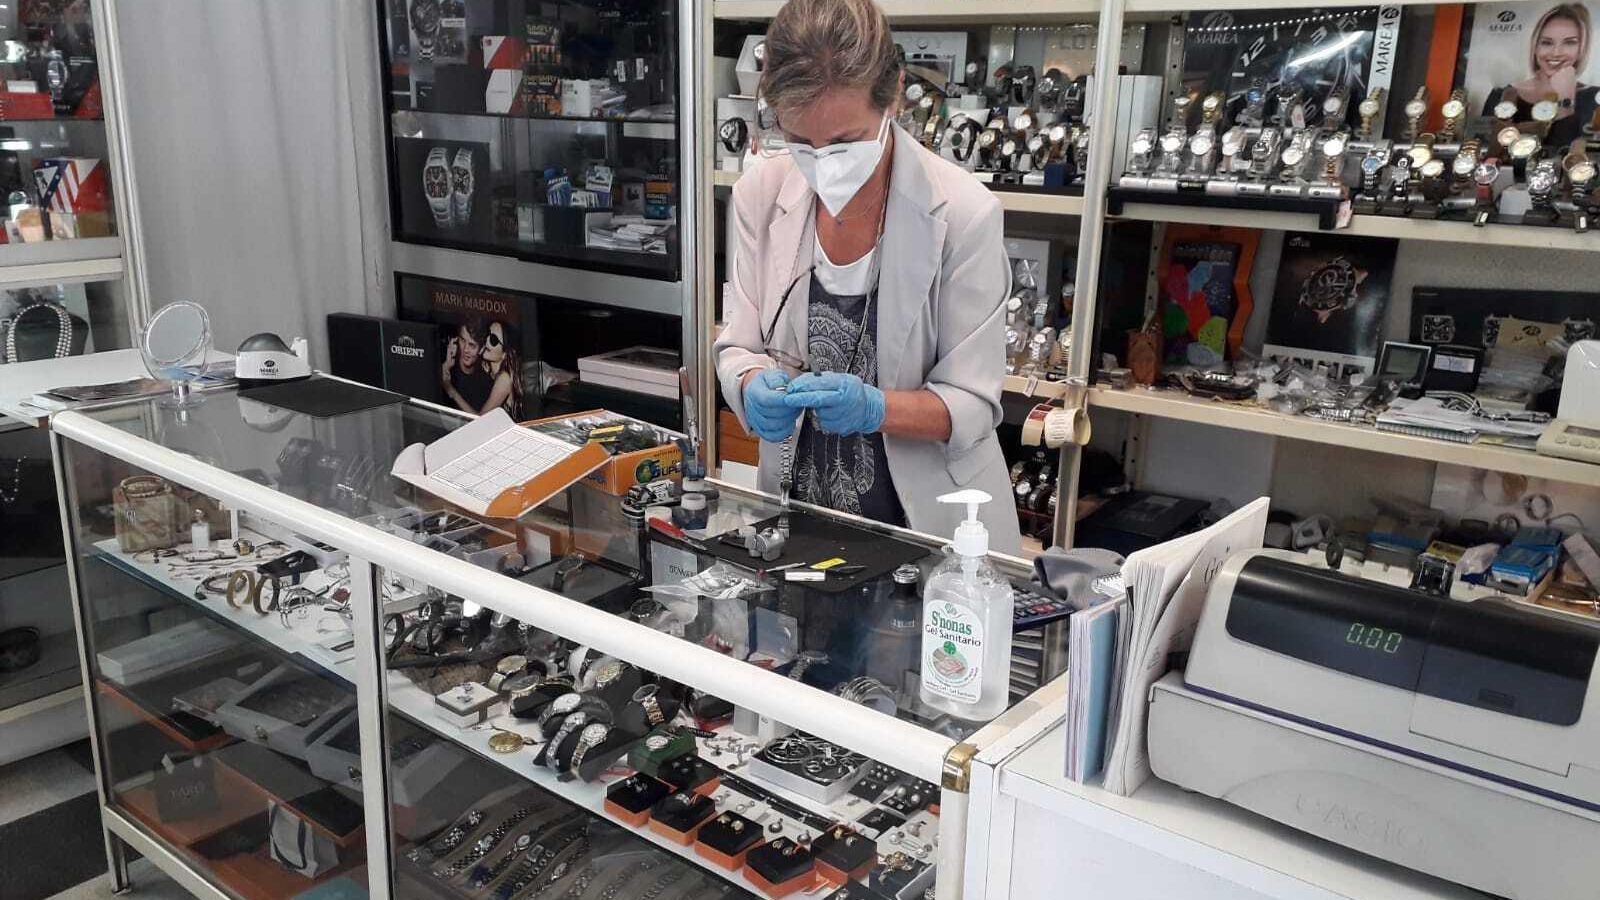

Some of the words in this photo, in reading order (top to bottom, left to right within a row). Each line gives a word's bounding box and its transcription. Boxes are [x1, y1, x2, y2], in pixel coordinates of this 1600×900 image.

[1194, 32, 1239, 45] MAREA
[1375, 21, 1395, 75] MAREA
[435, 291, 463, 307] MARK
[464, 297, 508, 314] MADDOX
[391, 345, 425, 358] ORIENT
[931, 610, 973, 636] S'nonas
[925, 624, 938, 636] Gel
[939, 630, 982, 647] Sanitario
[1346, 622, 1403, 654] 0.00
